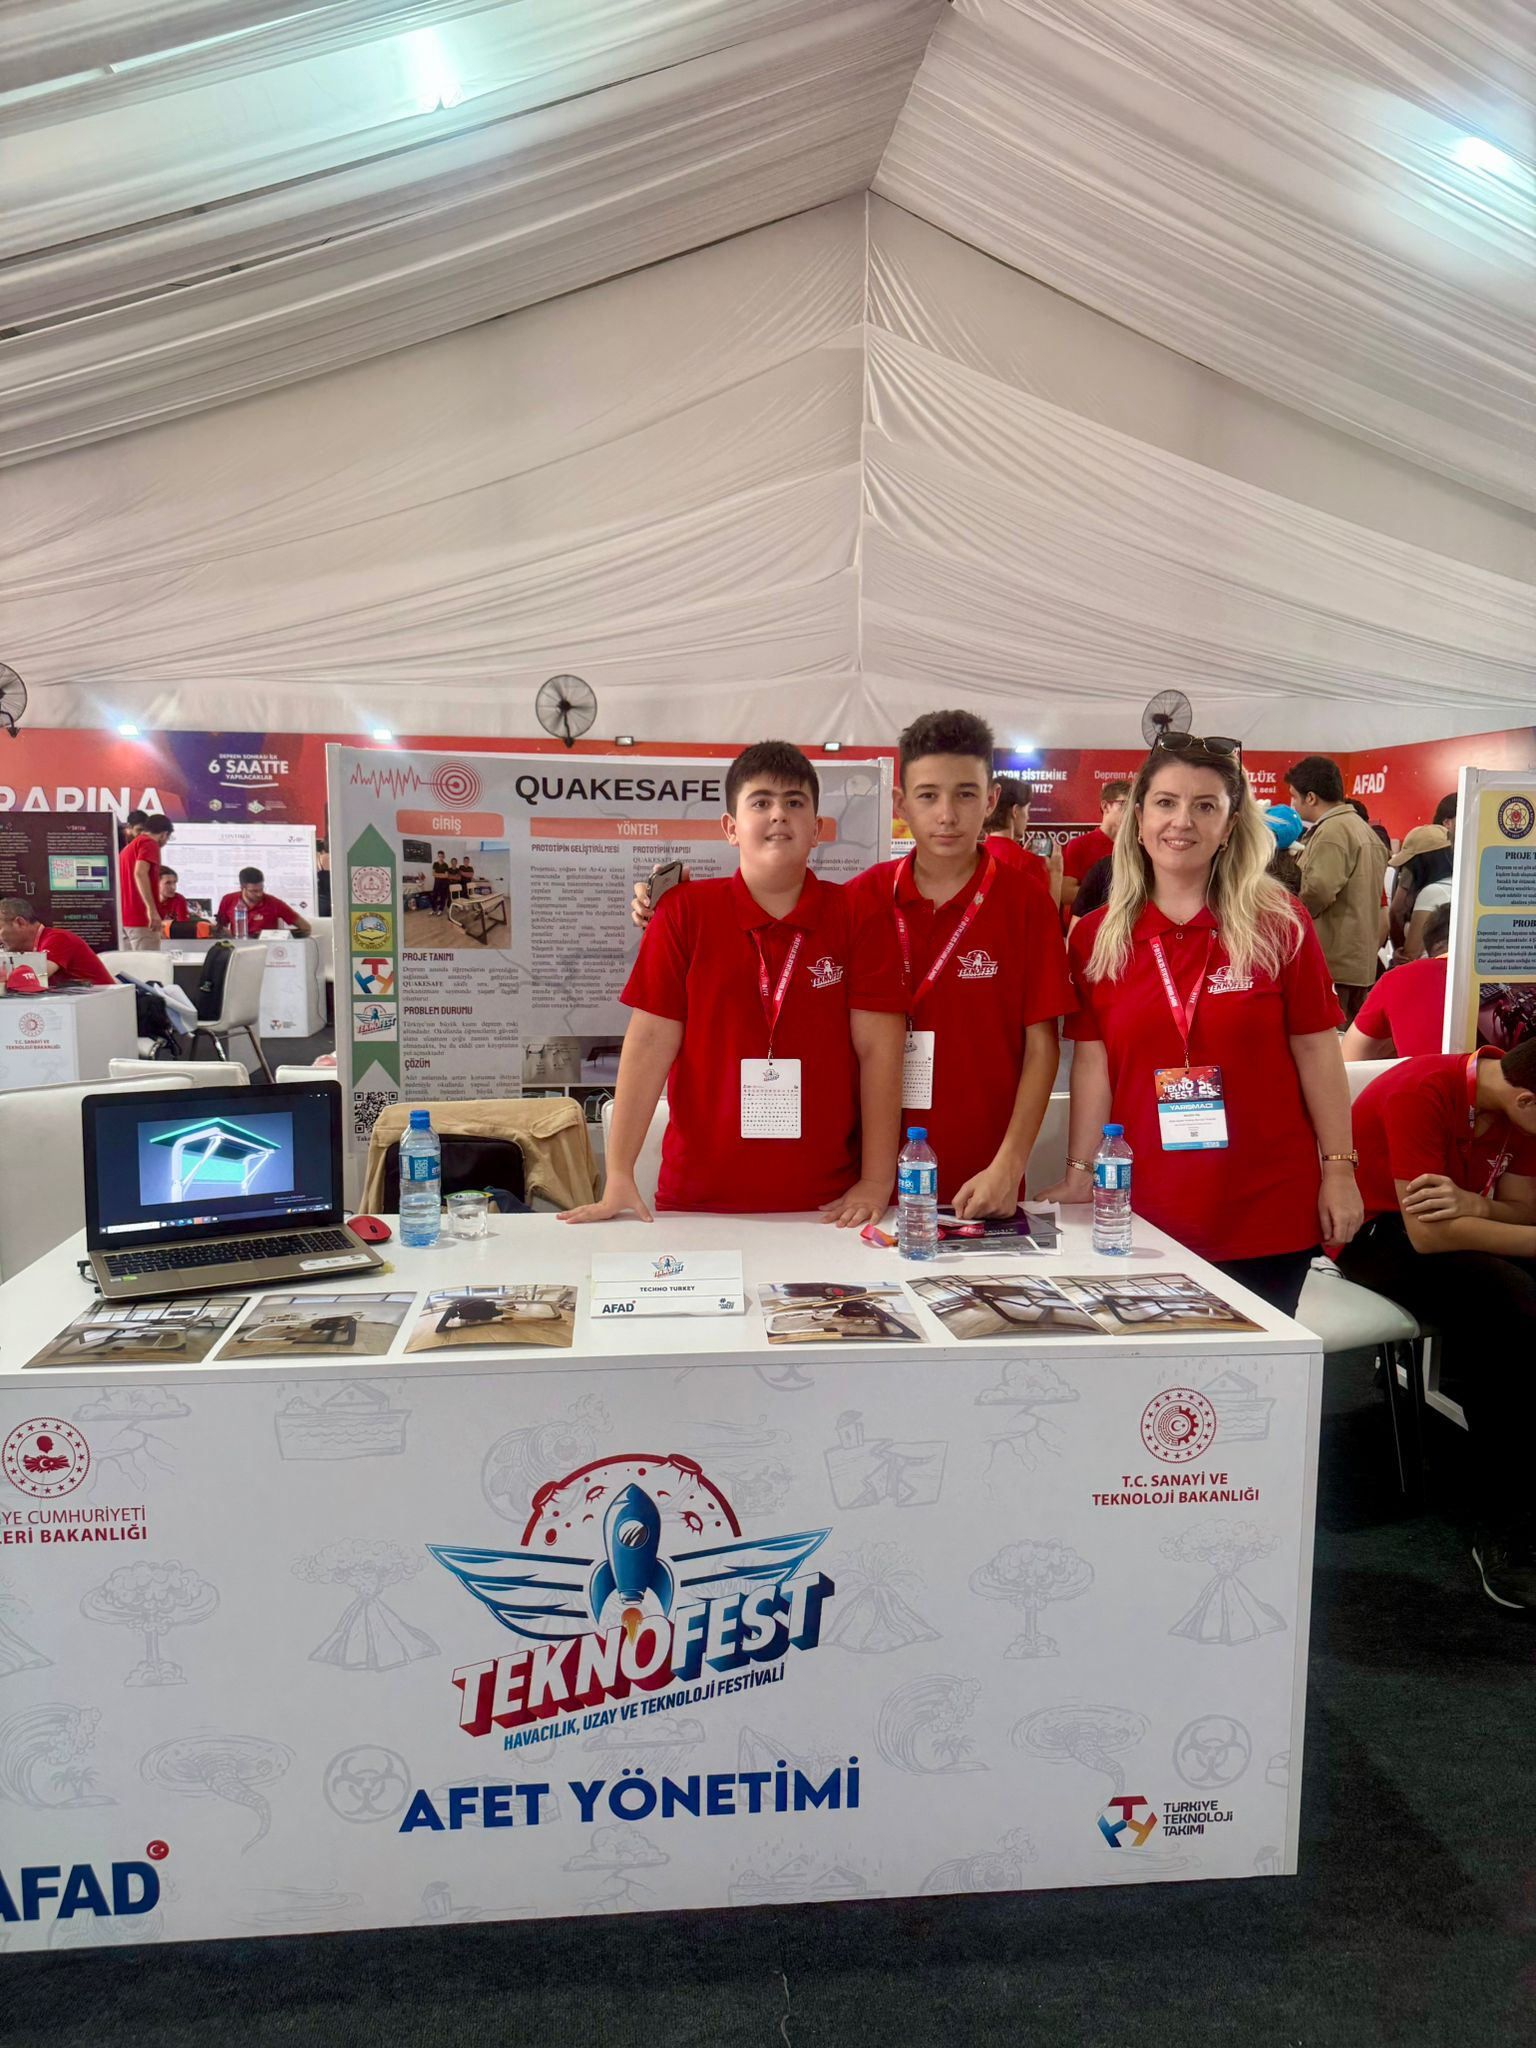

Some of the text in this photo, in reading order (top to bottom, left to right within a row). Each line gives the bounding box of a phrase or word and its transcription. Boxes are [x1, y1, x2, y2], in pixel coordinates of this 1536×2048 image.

[208, 760, 288, 774] 6 SAATTE
[1021, 768, 1067, 780] SİSTEMİNE
[1094, 770, 1126, 780] Deprem
[515, 775, 720, 805] QUAKESAFE
[1352, 772, 1385, 795] AFAD
[432, 817, 462, 835] GİRİŞ
[617, 822, 658, 836] YÖNTEM
[531, 844, 570, 853] PROTOTİPİN
[1505, 852, 1531, 860] PROJE
[402, 953, 454, 961] PROJE TANIMI
[404, 1007, 472, 1015] PROBLEM DURUMU
[405, 1058, 430, 1071] ÇÖZÜM
[1163, 1081, 1194, 1093] TEKNO
[1170, 1090, 1194, 1100] FEST
[602, 1303, 634, 1314] AFAD
[1122, 1471, 1228, 1487] T.C. SANAYİ VE
[1092, 1486, 1259, 1505] TEKNOLOJİ BAKANLIĞI
[28, 1505, 145, 1524] CUMHURİYETİ
[41, 1524, 147, 1543] BAKANLIĞI
[452, 1571, 836, 1738] TEKNOFEST
[503, 1663, 785, 1751] HAVACILIK, UZAY VE TEKNOLOJİ FESTİVALİ
[399, 1755, 860, 1833] AFET YÖNETİMİ
[1164, 1800, 1218, 1813] TÜRKİYE
[1163, 1811, 1233, 1824] TEKNOLOJİ
[1163, 1824, 1204, 1836] TAKIMI
